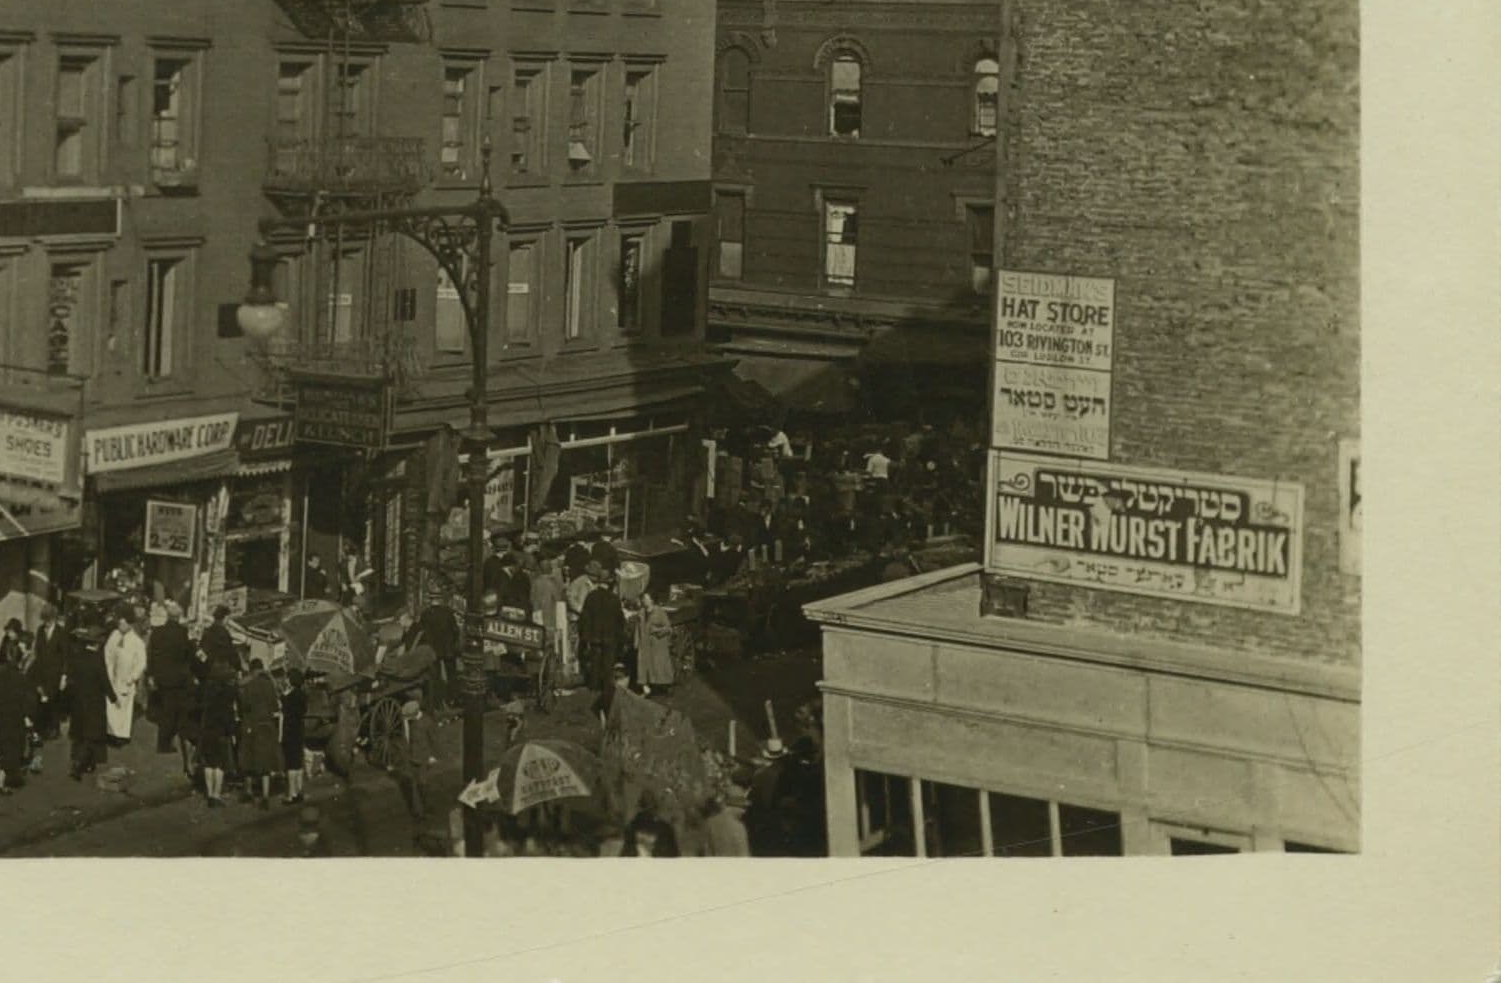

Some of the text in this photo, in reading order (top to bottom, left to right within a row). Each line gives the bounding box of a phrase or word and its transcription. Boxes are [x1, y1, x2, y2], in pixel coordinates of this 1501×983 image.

[1001, 297, 1109, 326] HAT STORE
[1029, 322, 1074, 334] LOCATED
[1081, 327, 1095, 335] AT
[999, 329, 1023, 348] 103
[1027, 334, 1093, 354] RIVINGTON
[1034, 352, 1075, 363] LUDLOW
[5, 434, 52, 458] SHOES
[94, 433, 135, 465] PUBLIC
[138, 424, 193, 458] HARDWARE
[1039, 472, 1108, 504] כשר
[998, 496, 1288, 576] WILNER WURST FABRIK
[485, 621, 523, 640] ALLEN
